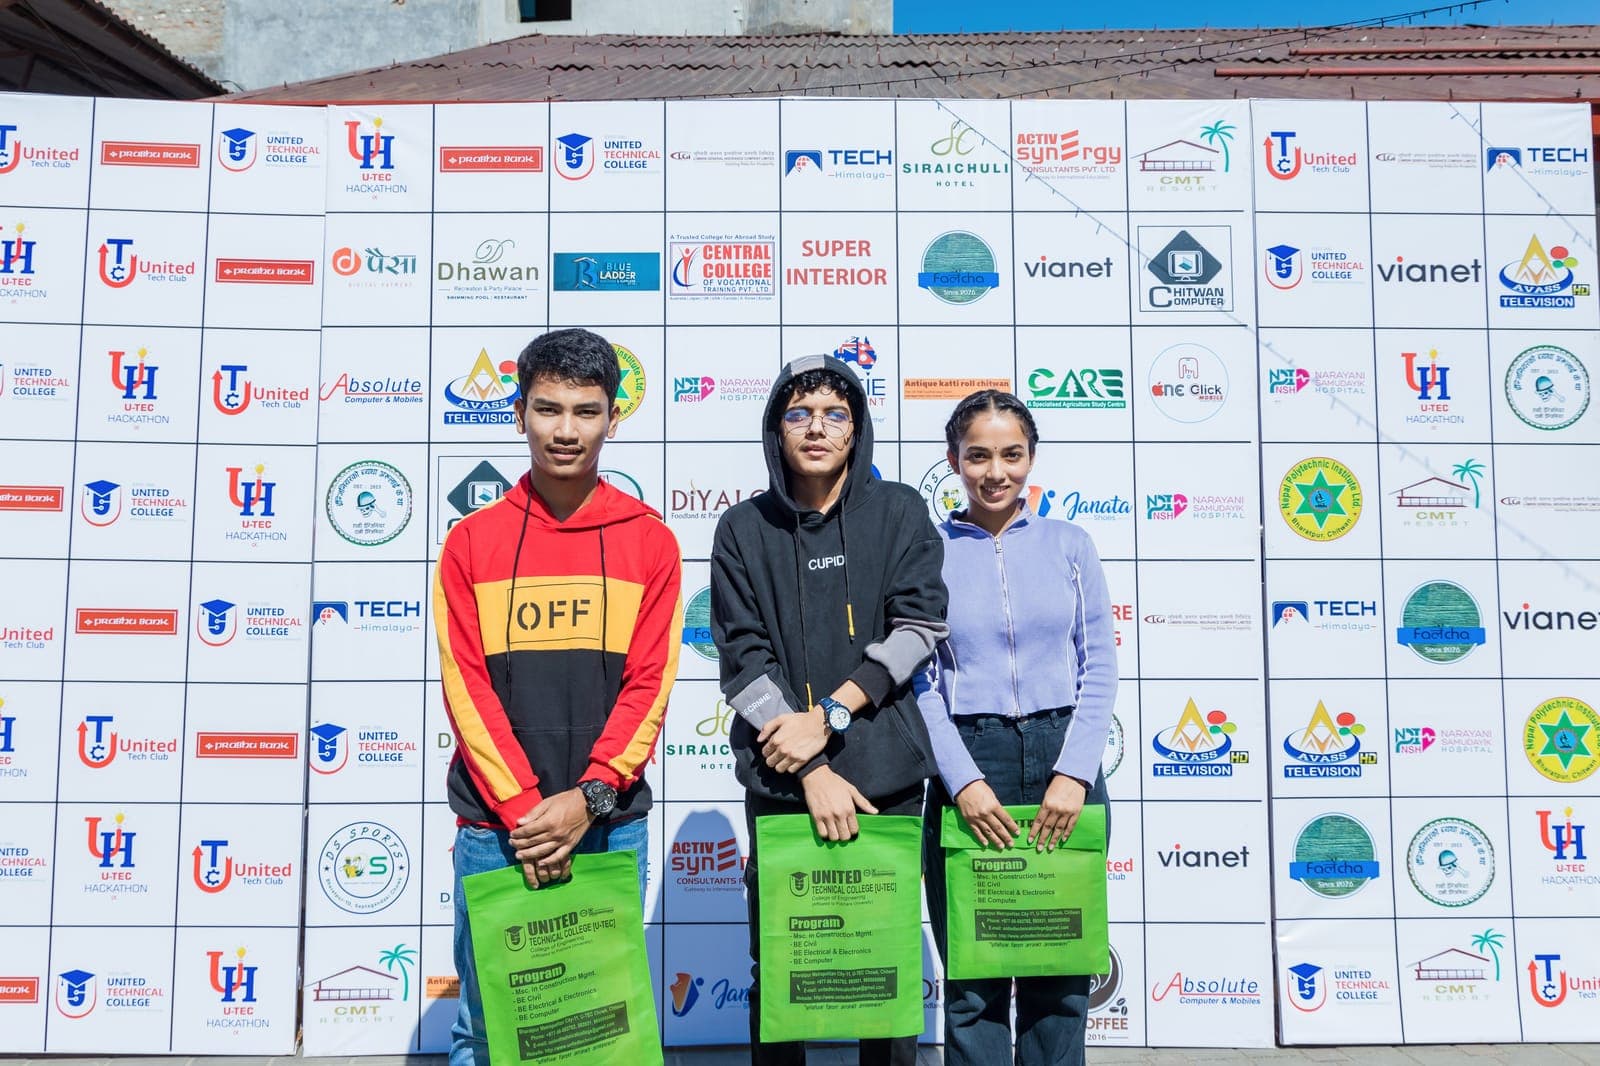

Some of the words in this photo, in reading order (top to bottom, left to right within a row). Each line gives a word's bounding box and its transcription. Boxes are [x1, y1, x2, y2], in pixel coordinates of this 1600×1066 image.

[266, 136, 304, 146] UNITED
[1017, 134, 1057, 144] ACTIV
[23, 146, 79, 161] United
[266, 146, 320, 155] TECHNICAL
[1528, 148, 1586, 162] TECH
[266, 154, 308, 164] COLLEGE
[828, 150, 892, 165] TECH
[1304, 153, 1356, 165] United
[30, 160, 51, 168] Tech
[52, 160, 72, 169] Club
[903, 164, 1009, 174] SIRAICHULI
[362, 173, 392, 181] U-TEC
[835, 170, 886, 180] Himalaya
[346, 184, 407, 193] HACKATHON
[703, 245, 771, 260] CENTRAL
[802, 240, 871, 257] SUPER
[140, 260, 196, 276] United
[438, 262, 538, 280] Dhawan
[703, 263, 772, 278] COLLEGE
[1024, 256, 1113, 277] vianet
[1378, 256, 1481, 282] vianet
[168, 274, 188, 282] Club
[600, 272, 636, 280] LADDER
[786, 268, 887, 285] INTERIOR
[1513, 283, 1561, 294] AVASS
[1502, 297, 1574, 307] TELEVISION
[14, 368, 52, 377] UNITED
[13, 378, 70, 387] TECHNICAL
[1028, 368, 1123, 398] CARE
[13, 387, 56, 396] COLLEGE
[254, 387, 310, 401] United
[124, 403, 154, 412] U-TEC
[282, 401, 301, 409] Club
[108, 414, 170, 424] HACKATHON
[132, 488, 170, 497] UNITED
[131, 498, 187, 507] TECHNICAL
[1063, 491, 1132, 520] Janata
[130, 507, 174, 516] COLLEGE
[1153, 512, 1173, 520] NSH
[242, 520, 272, 529] U-TEC
[226, 531, 287, 541] HACKATHON
[808, 555, 844, 570] CUPID
[247, 607, 285, 616] UNITED
[354, 602, 420, 616] TECH
[1314, 602, 1376, 616] TECH
[517, 600, 590, 630] OFF
[1503, 603, 1600, 630] viane
[246, 617, 302, 626] TECHNICAL
[246, 627, 289, 636] COLLEGE
[361, 624, 412, 632] Himalaya
[120, 739, 177, 752] United
[150, 753, 169, 761] Club
[1168, 751, 1218, 762] AVASS
[1230, 752, 1248, 762] HD
[1298, 753, 1347, 764] AVASS
[1155, 765, 1231, 776] TELEVISION
[1286, 766, 1360, 777] TELEVISION
[350, 826, 403, 858] SPORTS
[672, 842, 714, 854] ACTIV
[1158, 844, 1249, 867] vianet
[235, 864, 292, 877] United
[974, 860, 1023, 871] Program
[101, 872, 132, 881] U-TEC
[812, 870, 862, 884] UNITED
[84, 884, 148, 893] HACKATHON
[812, 885, 845, 894] TECHNICAL
[847, 884, 874, 894] COLLEGE
[875, 883, 896, 893] [U-TEC]
[528, 912, 579, 936] UNITED
[790, 919, 840, 930] Program
[529, 934, 563, 946] TECHNICAL
[564, 925, 592, 938] COLLEGE
[593, 919, 615, 931] [U-TEC]
[512, 966, 562, 987] Program
[539, 975, 576, 991] Construction
[107, 988, 164, 997] TECHNICAL
[1436, 985, 1476, 994] CMT
[106, 998, 150, 1007] COLLEGE
[1179, 998, 1218, 1006] Computer
[334, 1006, 380, 1015] CMT
[529, 1008, 560, 1019] Computer
[207, 1019, 269, 1028] HACKATHON
